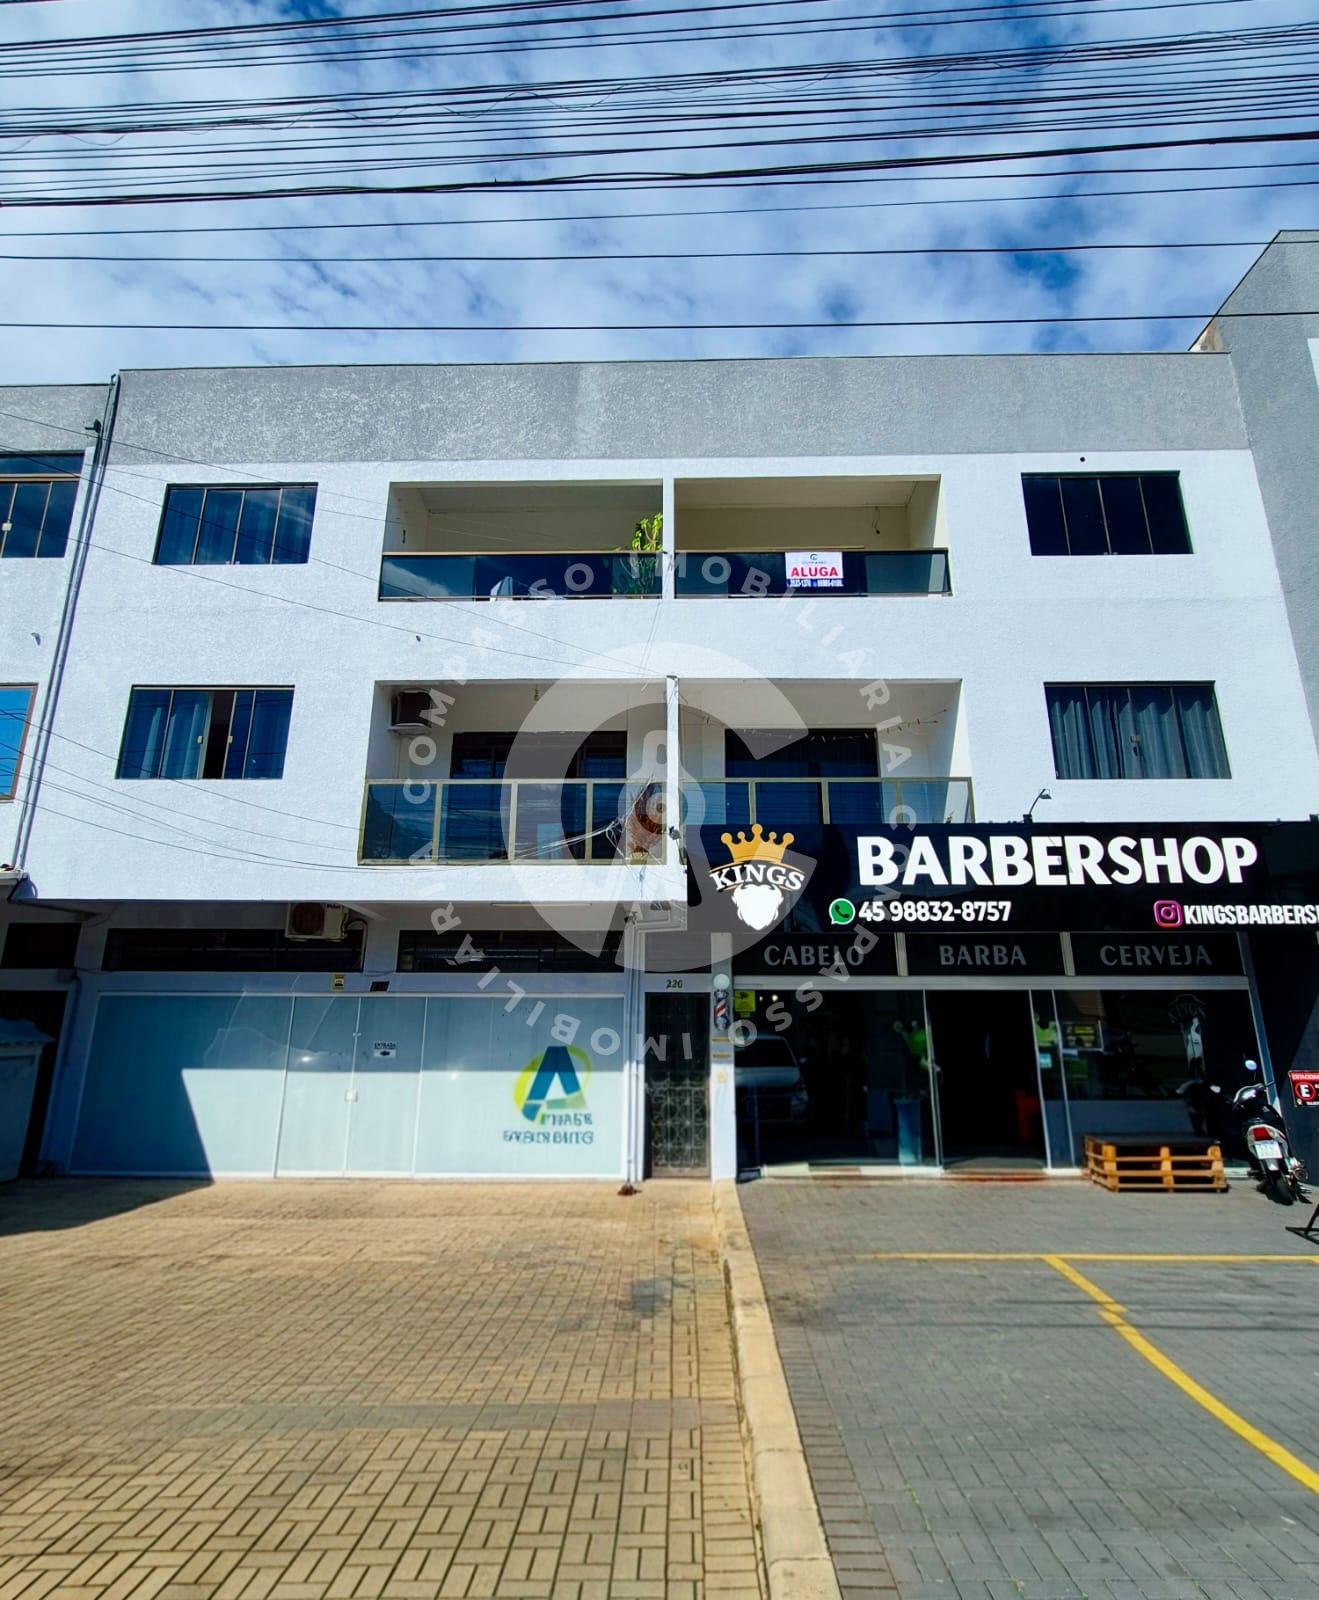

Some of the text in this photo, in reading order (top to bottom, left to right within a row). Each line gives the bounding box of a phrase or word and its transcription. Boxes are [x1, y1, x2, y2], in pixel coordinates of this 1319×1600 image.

[791, 566, 838, 577] ALUGA
[857, 836, 1258, 886] BARBERSHOP
[708, 863, 805, 892] KINGS
[858, 901, 1011, 923] 45 98832-8757
[1183, 904, 1319, 924] KINGSBARBERS
[763, 944, 865, 967] CABELO
[939, 945, 1028, 966] BARBA
[1099, 944, 1213, 967] CERVEJA
